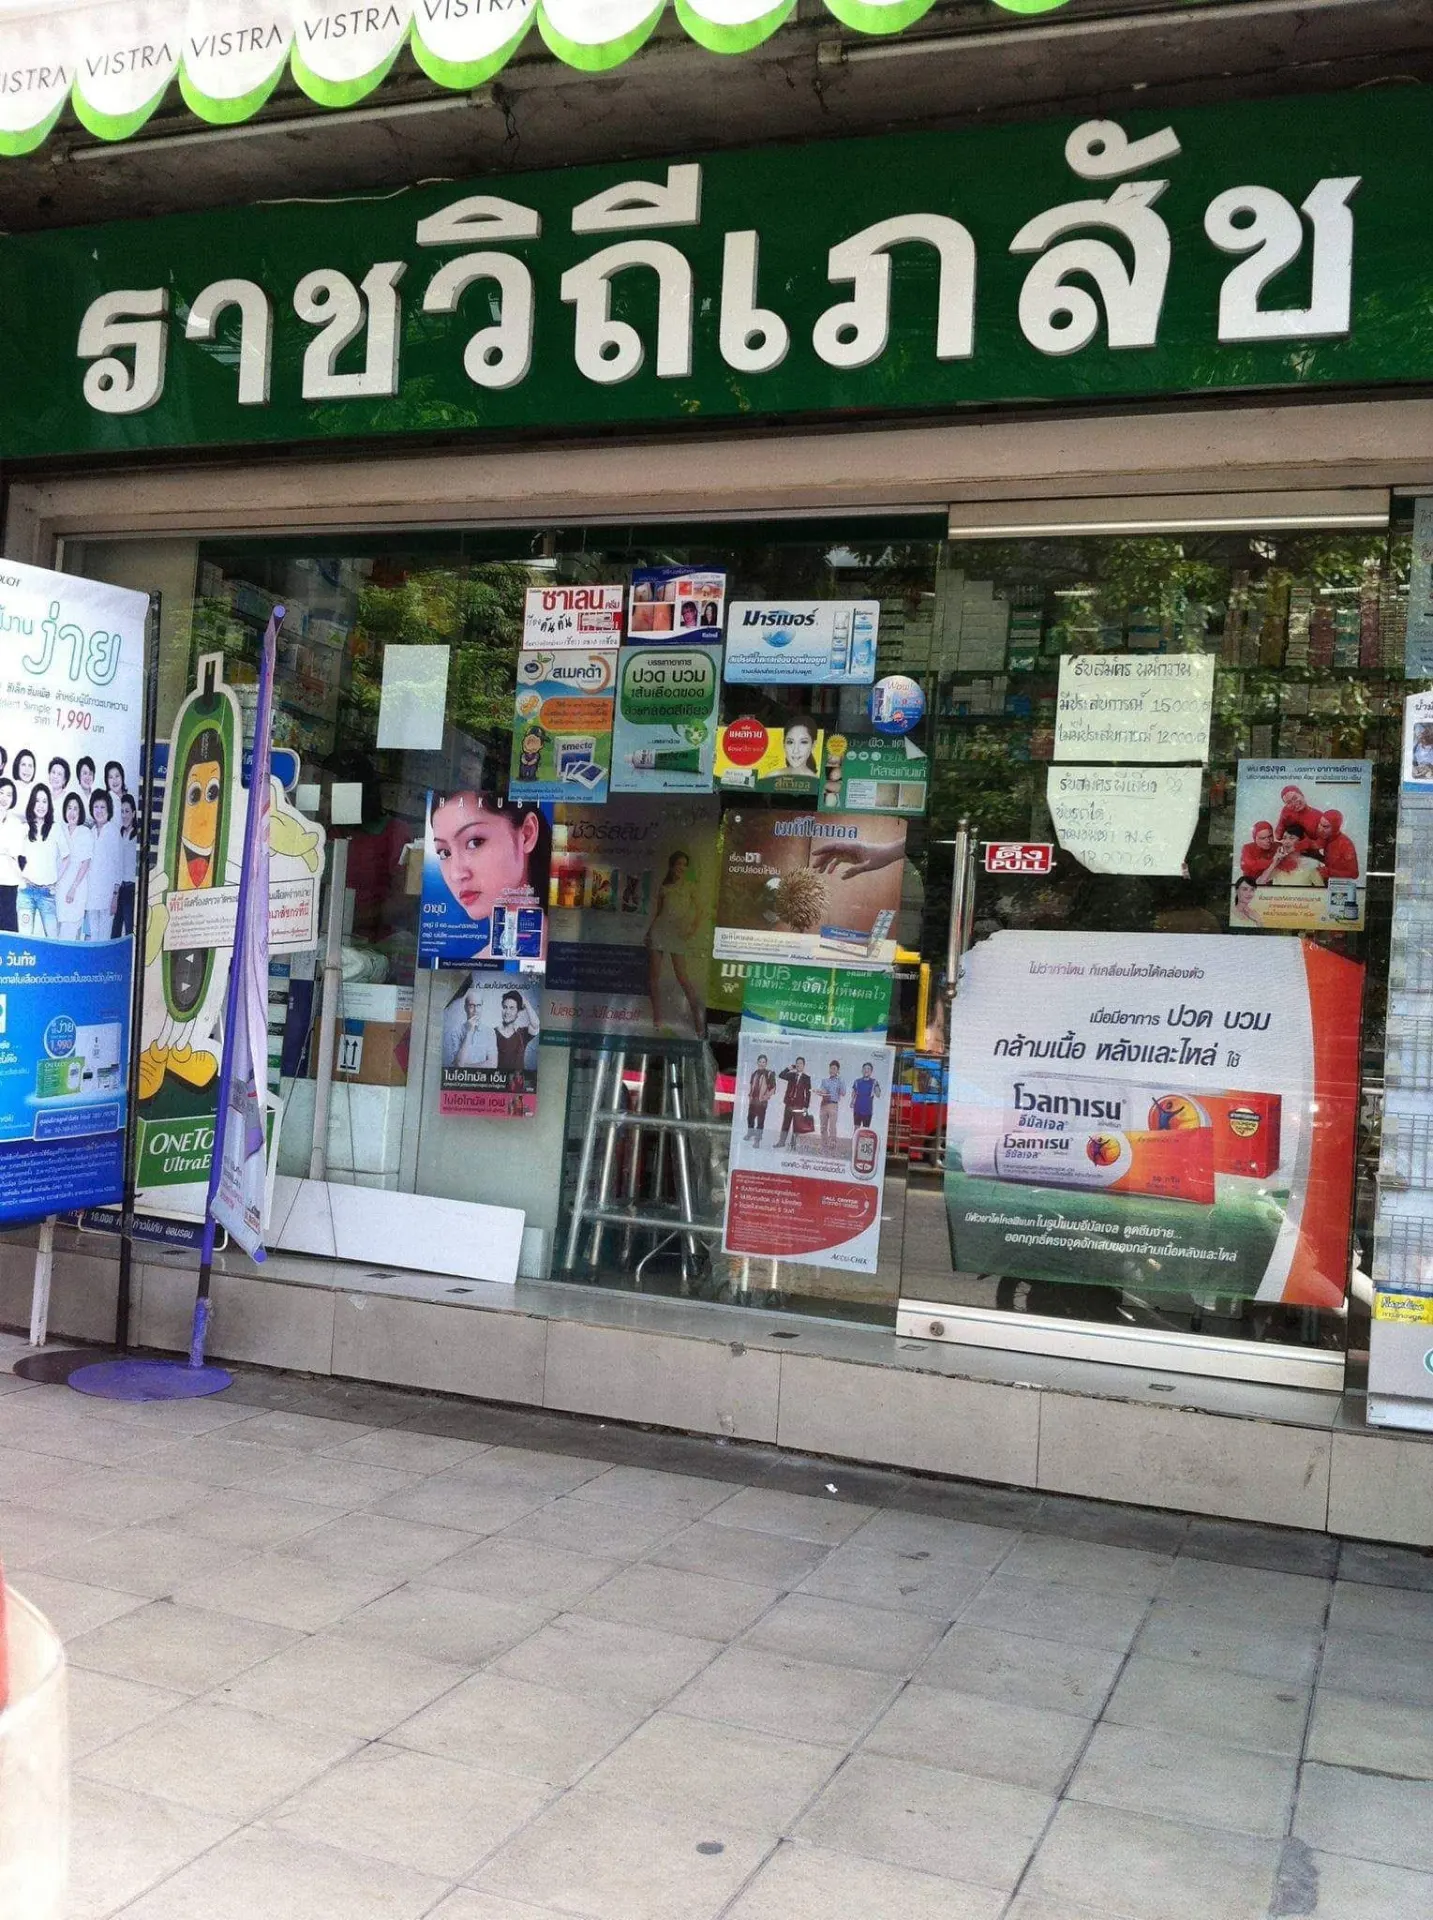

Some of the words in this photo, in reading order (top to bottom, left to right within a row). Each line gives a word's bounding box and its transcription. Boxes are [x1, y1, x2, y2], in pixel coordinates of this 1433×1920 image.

[304, 5, 400, 41] VISTRA
[190, 24, 284, 58] VISTRA
[86, 43, 173, 77] VISTRA
[0, 66, 67, 94] ISTRA
[77, 120, 1362, 415] ราชวิถีเภสัช
[542, 589, 604, 611] ซาเลน
[742, 607, 820, 626] มารีเมอร์
[22, 601, 122, 686] ง่าย
[647, 659, 693, 667] บรรเทาอาการ
[632, 668, 665, 683] ปวด
[672, 669, 706, 682] บวม
[631, 685, 705, 698] เส้นเลือดขอด
[55, 708, 92, 732] 1,990
[439, 797, 541, 809] HAKUBI
[996, 844, 1043, 859] ดึง
[991, 859, 1046, 870] PULL
[779, 1010, 847, 1028] MUCOFLUX
[1089, 1007, 1161, 1026] เมื่อมีอาการ
[1167, 1004, 1213, 1028] ปวด
[1223, 1011, 1271, 1031] บวม
[993, 1030, 1086, 1060] กล้ามเนื้อ
[1095, 1037, 1218, 1067] หลังและไหล่
[1226, 1050, 1240, 1068] ใช้
[1013, 1083, 1122, 1120] โวลทาเรน
[1003, 1133, 1070, 1150] โวลทาเรน
